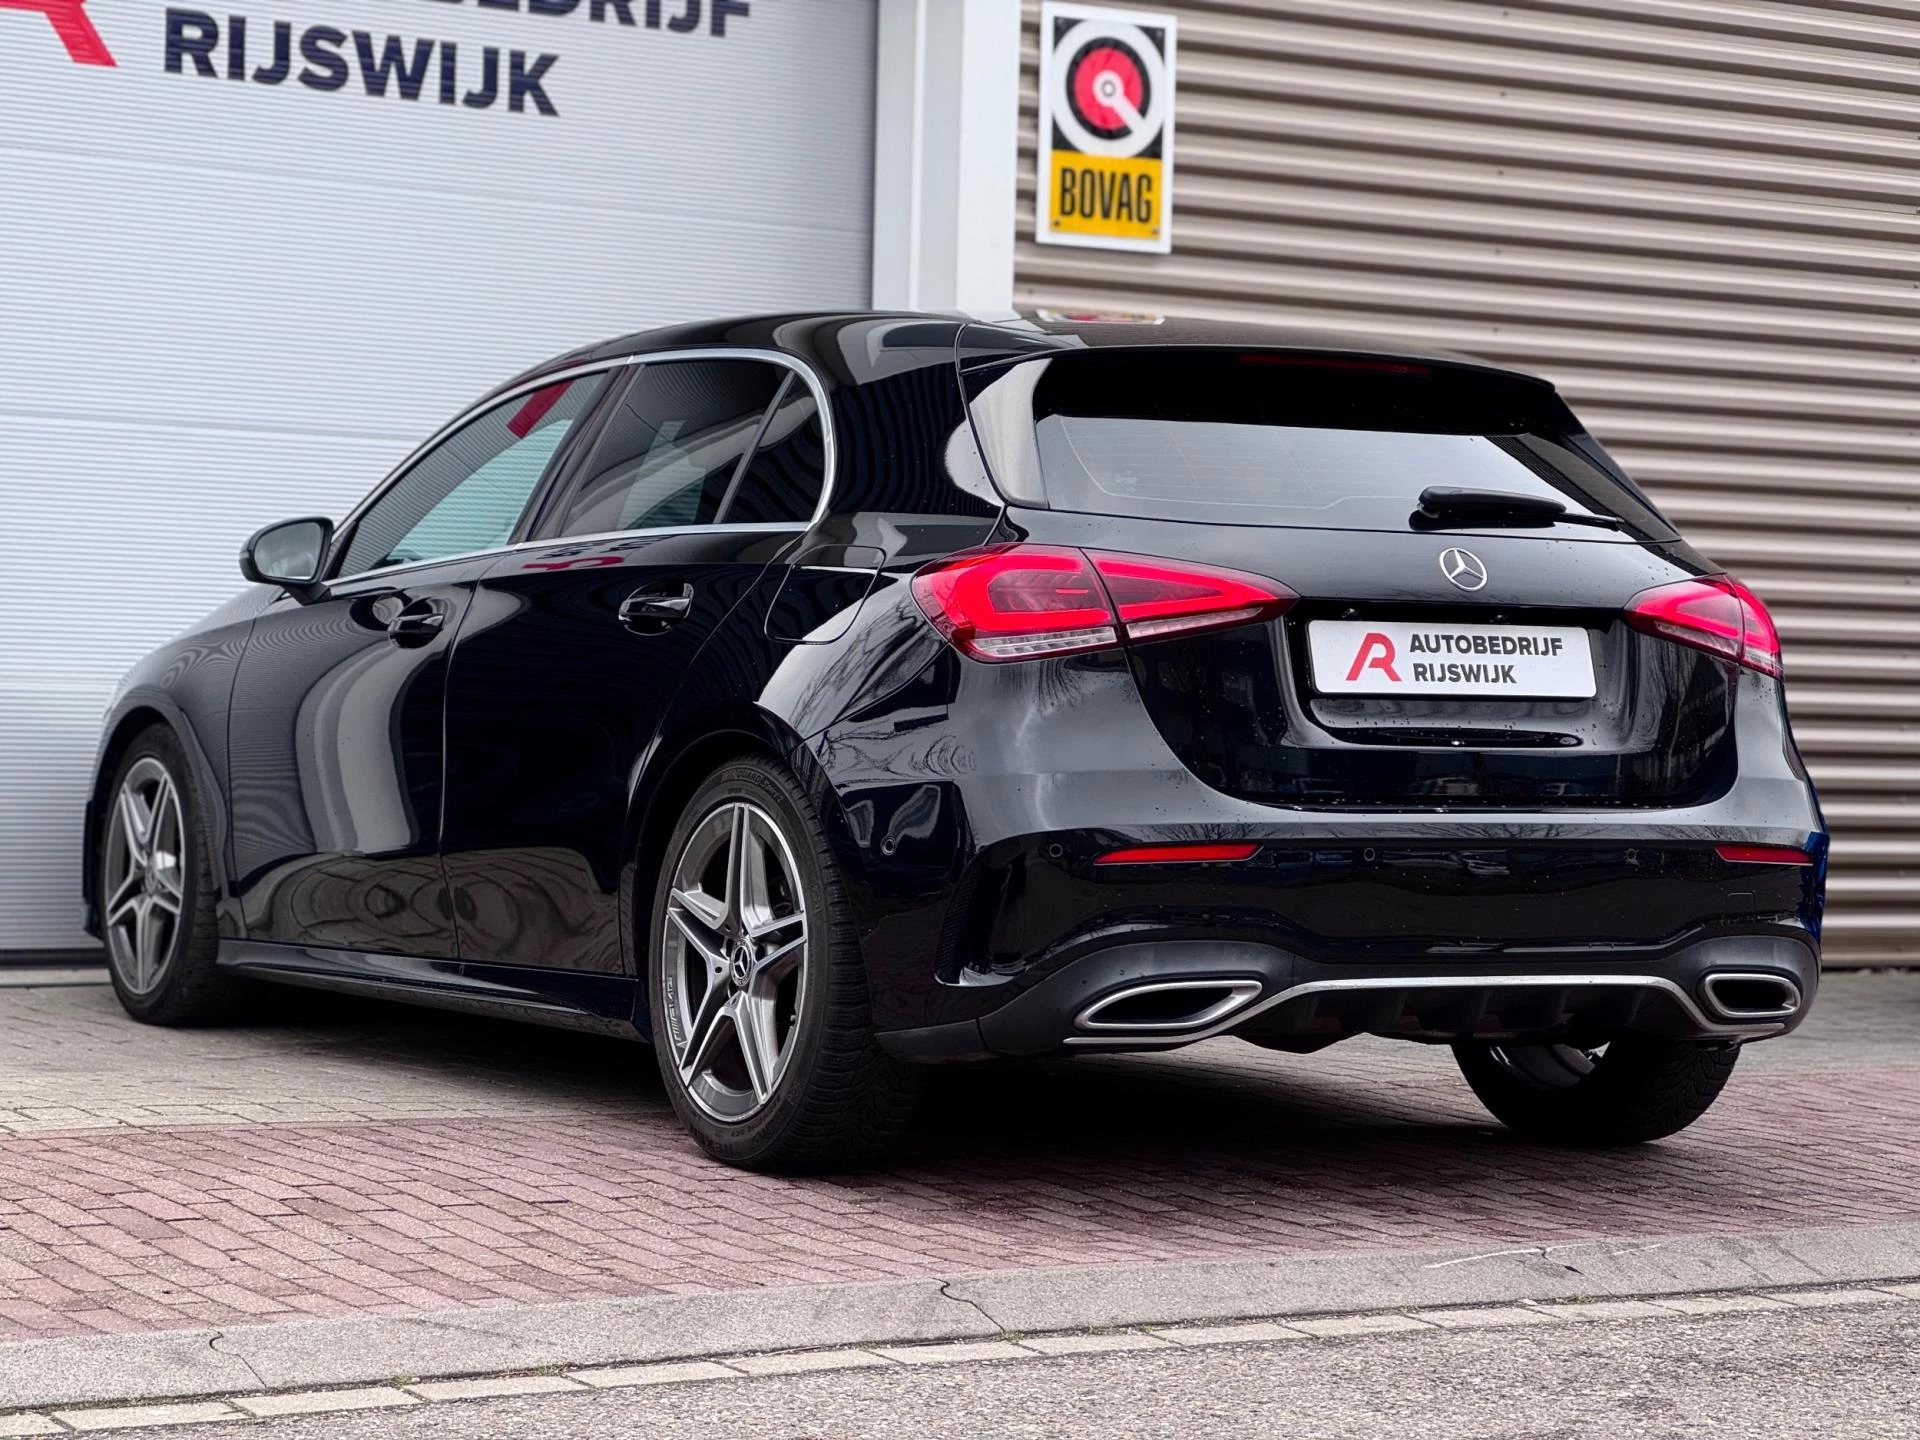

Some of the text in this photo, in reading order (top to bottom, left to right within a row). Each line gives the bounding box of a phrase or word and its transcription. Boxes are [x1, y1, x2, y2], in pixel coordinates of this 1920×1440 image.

[164, 8, 559, 116] RIJSWIJK
[1060, 167, 1153, 223] BOVAG
[1409, 633, 1563, 656] AUTOBEDRIJF
[1413, 663, 1518, 684] RIJSWIJK
